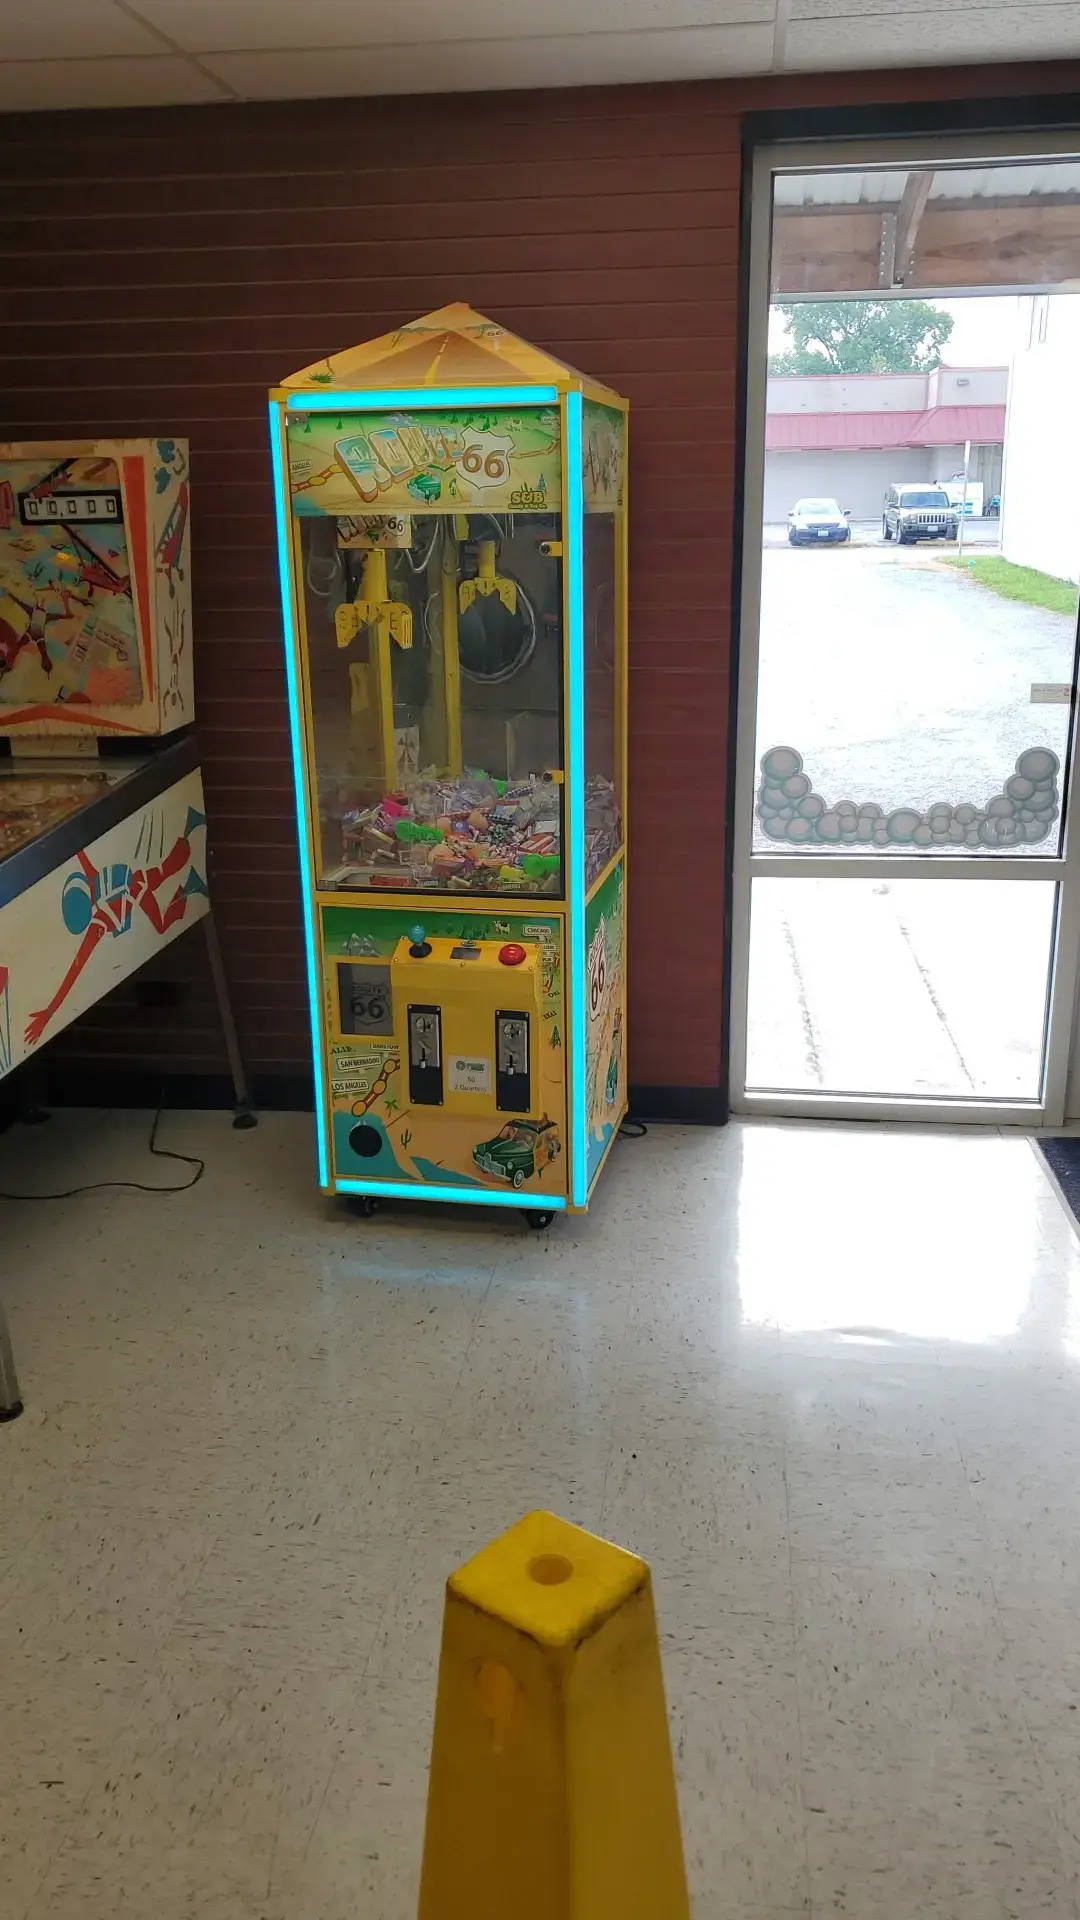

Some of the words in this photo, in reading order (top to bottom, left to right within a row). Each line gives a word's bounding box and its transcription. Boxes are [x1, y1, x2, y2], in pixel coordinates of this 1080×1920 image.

[334, 425, 463, 503] ROUTE
[463, 444, 505, 478] 66
[511, 491, 544, 503] S&B
[388, 517, 404, 532] 66
[349, 995, 386, 1019] 66
[542, 1010, 557, 1021] EXAS
[340, 1060, 353, 1068] SAN
[332, 1083, 345, 1091] LOS
[345, 1081, 367, 1090] ANGELES
[460, 1084, 487, 1092] Quarters
